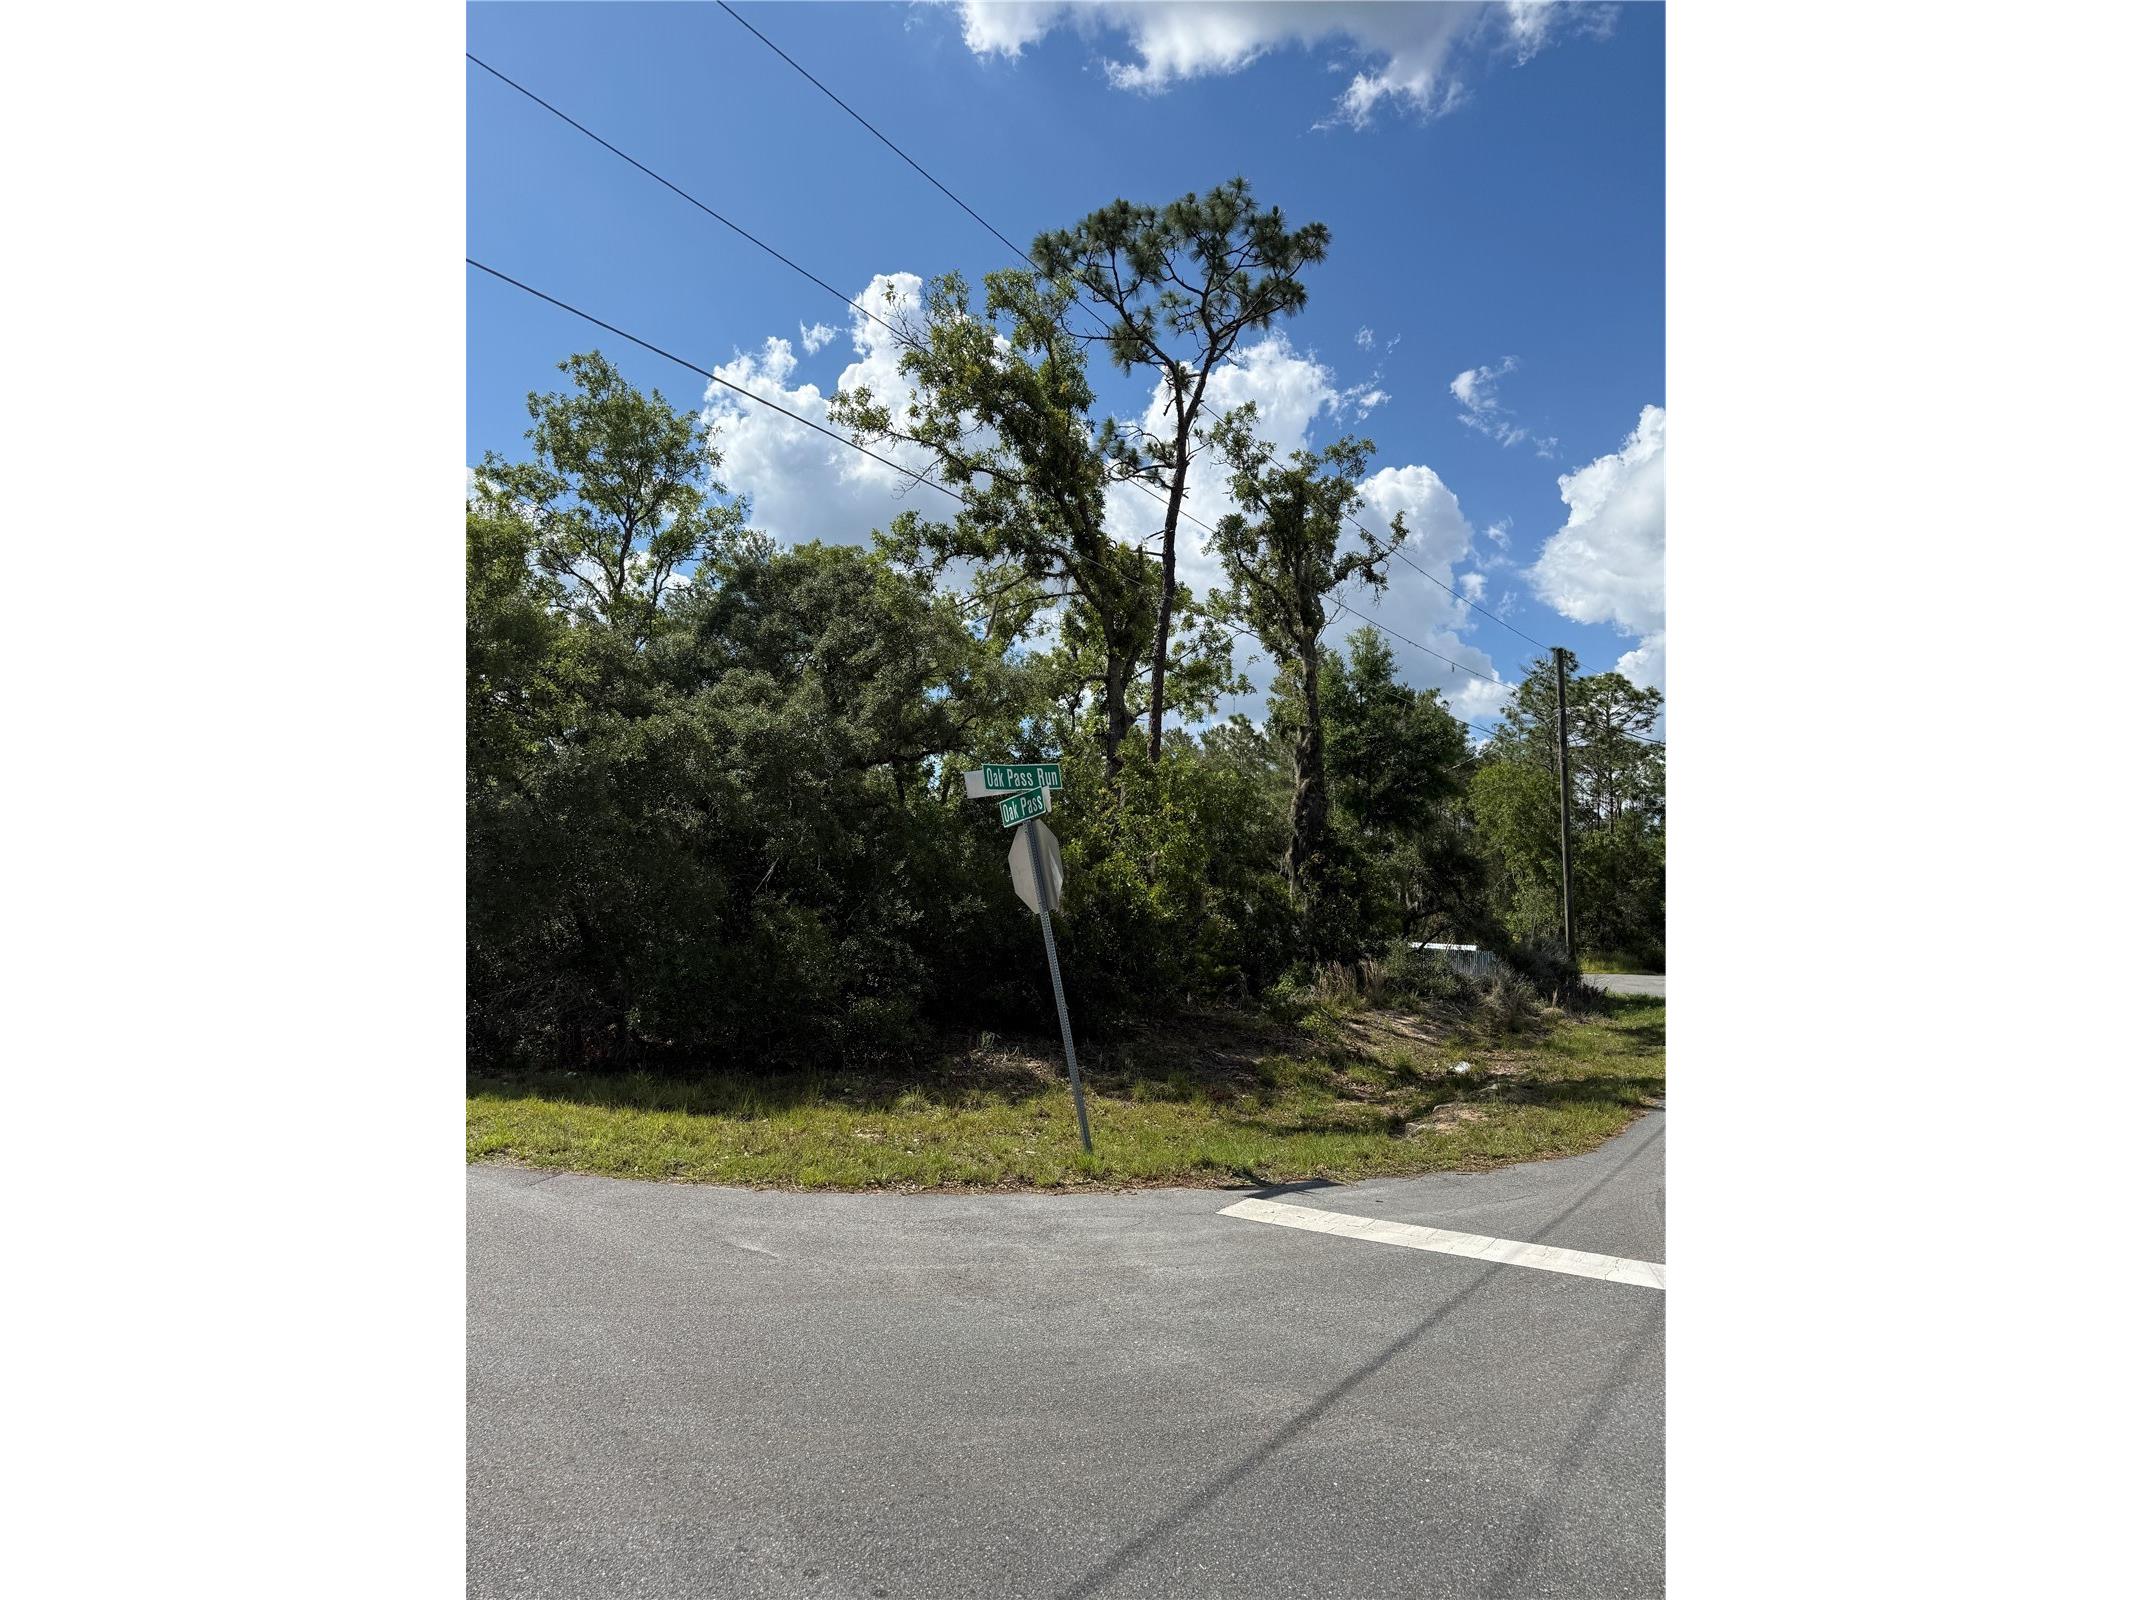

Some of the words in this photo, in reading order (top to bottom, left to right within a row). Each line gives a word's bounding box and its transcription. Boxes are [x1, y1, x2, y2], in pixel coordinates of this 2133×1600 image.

[986, 768, 1004, 787] Oak
[1007, 769, 1034, 787] Pass
[1037, 768, 1058, 786] Run
[1002, 801, 1019, 823] Oak
[1020, 795, 1043, 816] Pass
